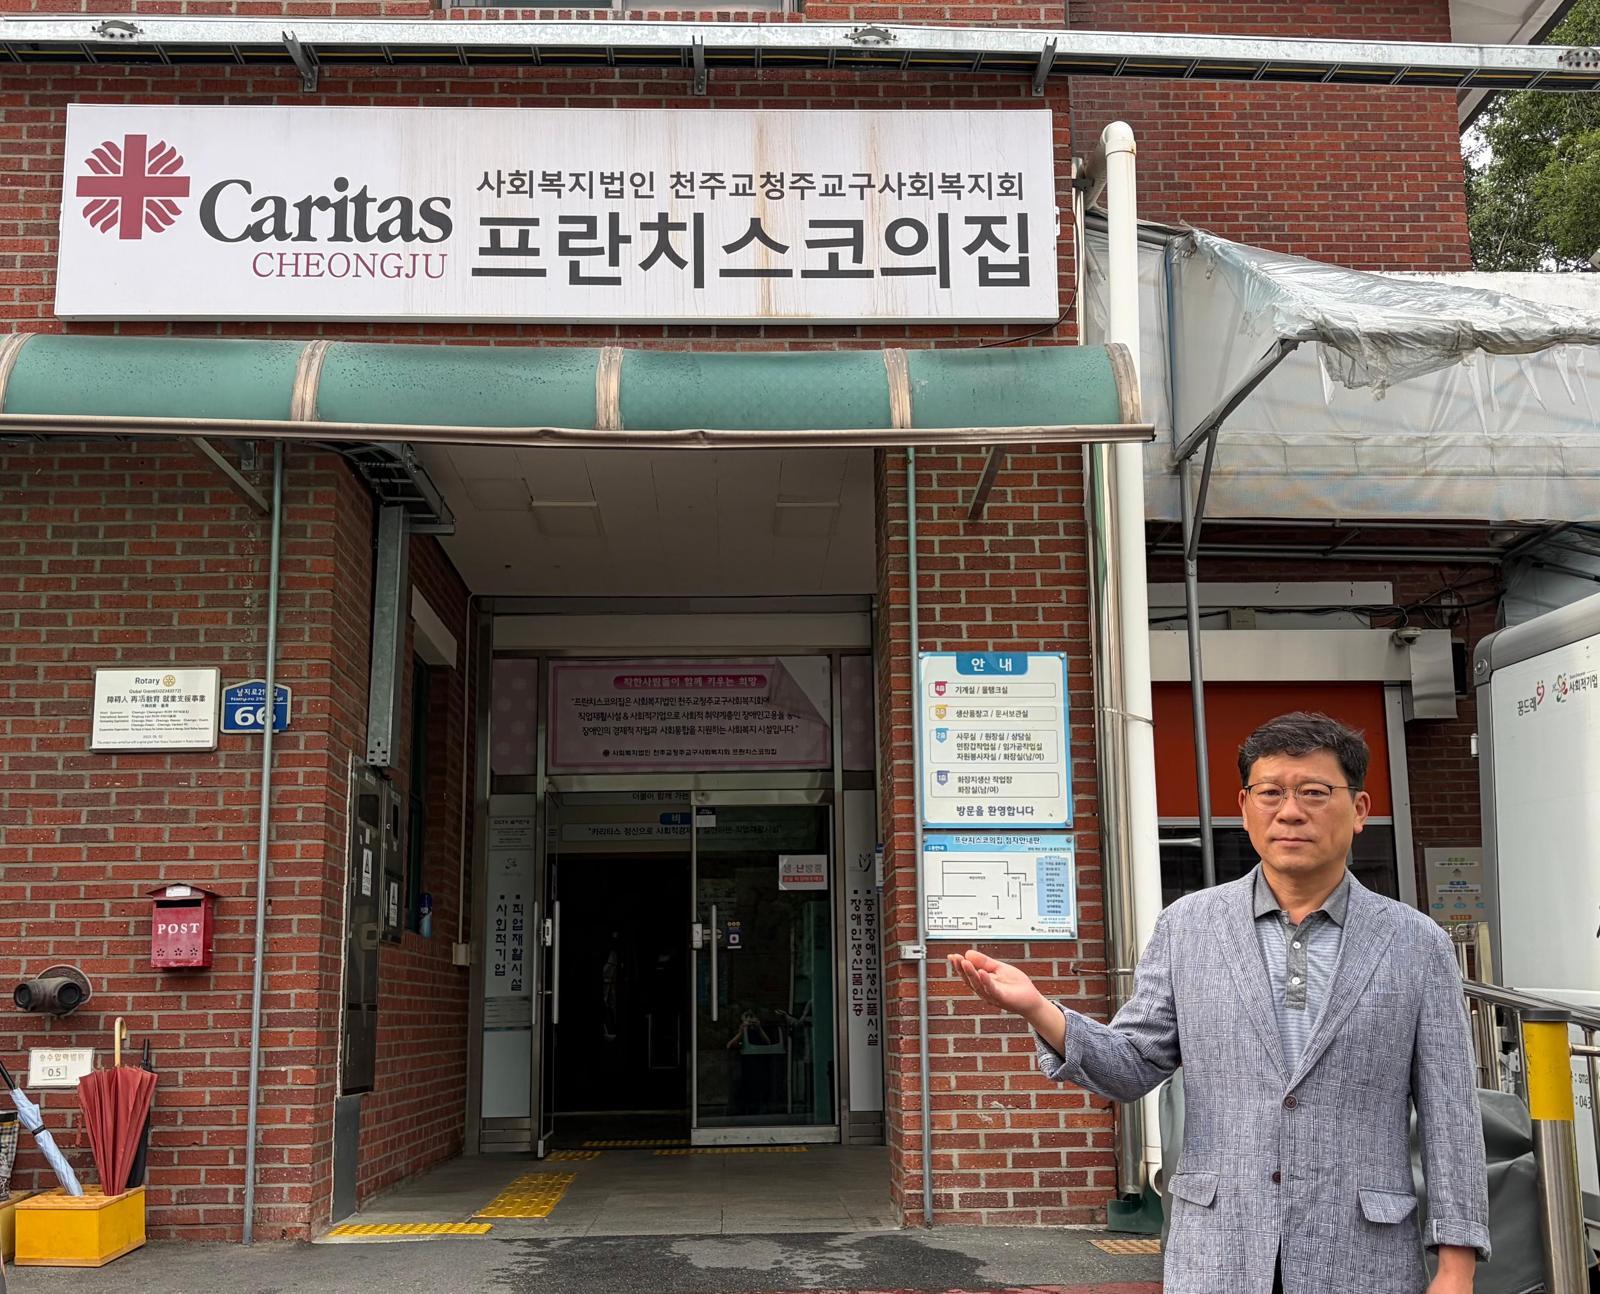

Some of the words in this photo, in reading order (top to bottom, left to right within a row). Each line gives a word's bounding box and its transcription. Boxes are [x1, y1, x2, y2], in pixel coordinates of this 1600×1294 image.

[476, 168, 656, 200] 사회복지법인
[669, 169, 1025, 202] 천주교청주교구사회복지회
[199, 176, 453, 243] Caritas
[471, 210, 1031, 290] 프란치스코의집
[252, 251, 448, 280] CHEONGJU
[134, 676, 160, 686] Rotary
[684, 677, 703, 687] 함께
[738, 676, 756, 686] 희망
[1568, 674, 1598, 694] 사회적기업
[956, 686, 976, 694] 기계실
[633, 697, 677, 706] 사회복지법인
[234, 706, 276, 726] 66
[578, 712, 622, 721] 직업재활시설
[630, 712, 680, 721] 사회적기업으로
[682, 711, 704, 720] 사회적
[705, 711, 741, 720] 취약계층인
[996, 710, 1028, 718] 문서보관실
[582, 727, 610, 736] 장애인의
[612, 726, 634, 736] 경제적
[635, 726, 658, 736] 자립과
[660, 726, 696, 735] 사회통합을
[698, 725, 726, 735] 지원하는
[728, 725, 756, 735] 사회복지
[956, 806, 984, 816] 방문을
[988, 806, 1034, 817] 환영합니다
[955, 836, 1004, 845] 프란치스코의집
[1005, 836, 1041, 844] 점자안내판
[158, 922, 200, 934] POST
[494, 904, 508, 976] 사회적기업
[511, 904, 524, 991] 직업재활시설
[851, 898, 864, 1016] 장애인생산품인증
[864, 898, 879, 1047] 중증장애인생산품시설
[48, 1068, 61, 1077] 0.5
